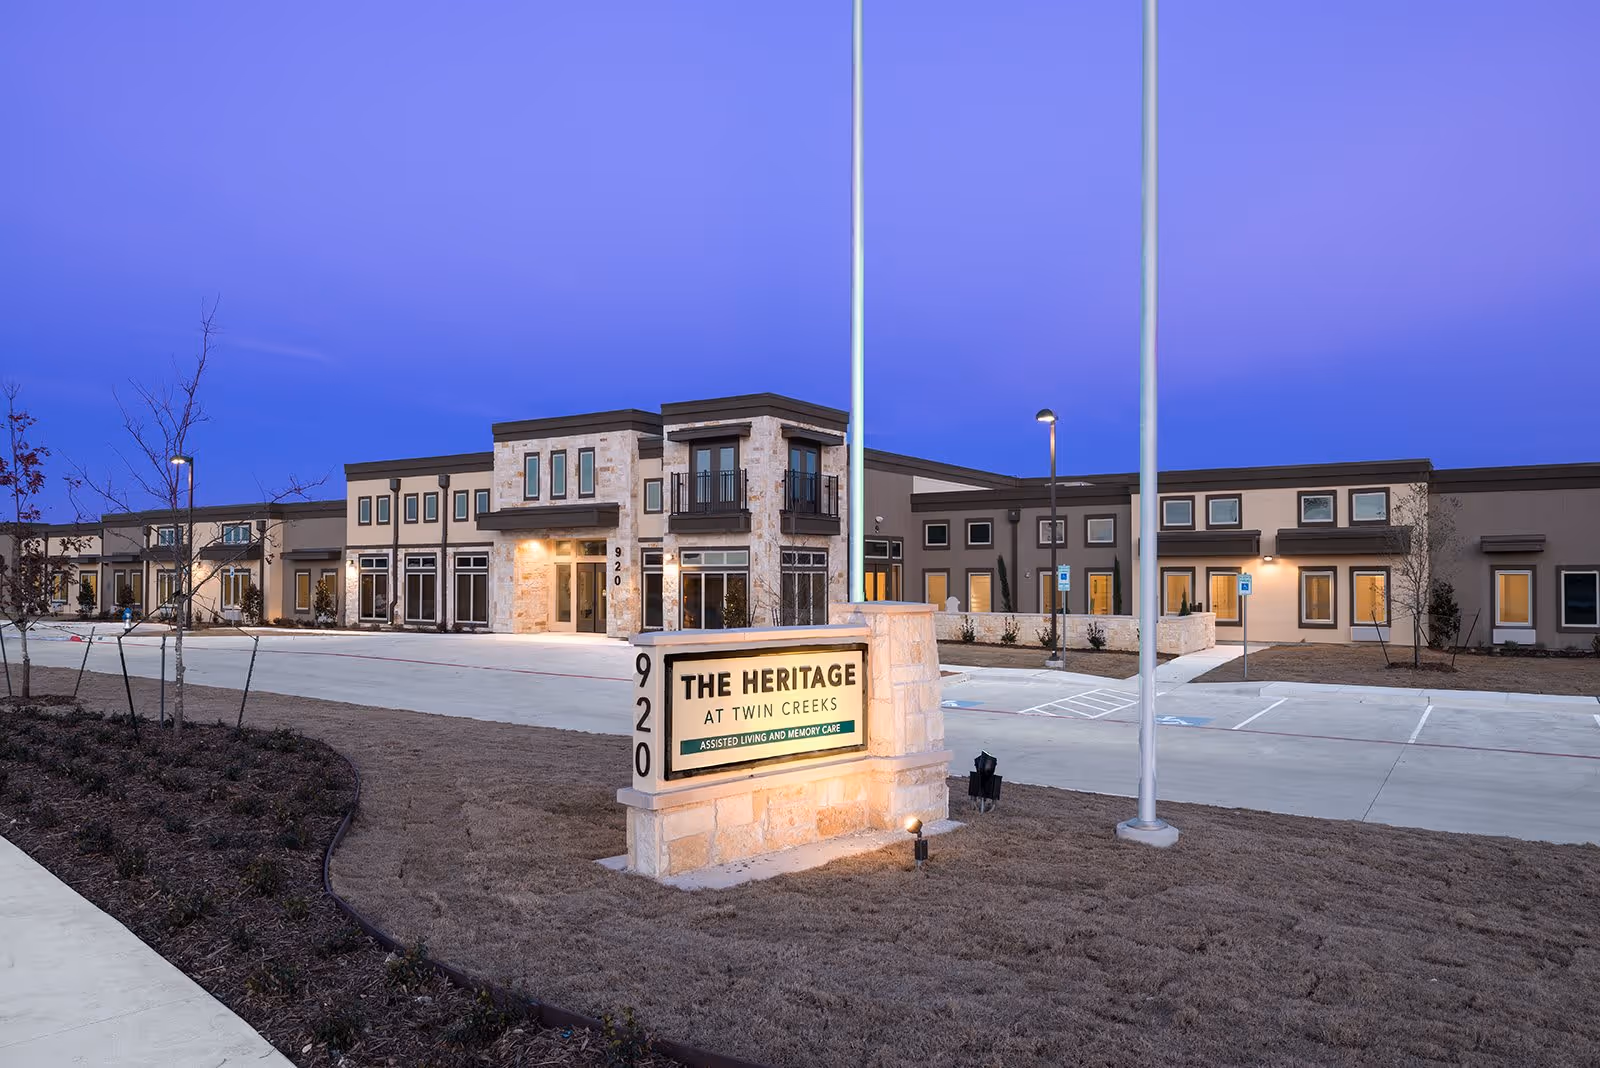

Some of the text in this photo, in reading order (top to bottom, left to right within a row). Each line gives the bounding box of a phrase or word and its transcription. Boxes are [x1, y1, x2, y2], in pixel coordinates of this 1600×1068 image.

[614, 547, 622, 586] 920
[680, 663, 856, 700] THE HERITAGE
[635, 652, 652, 778] 920
[703, 697, 838, 725] AT TWIN CREEKS
[699, 723, 841, 750] ASSISTED LIVING AND MEMORY CARE
